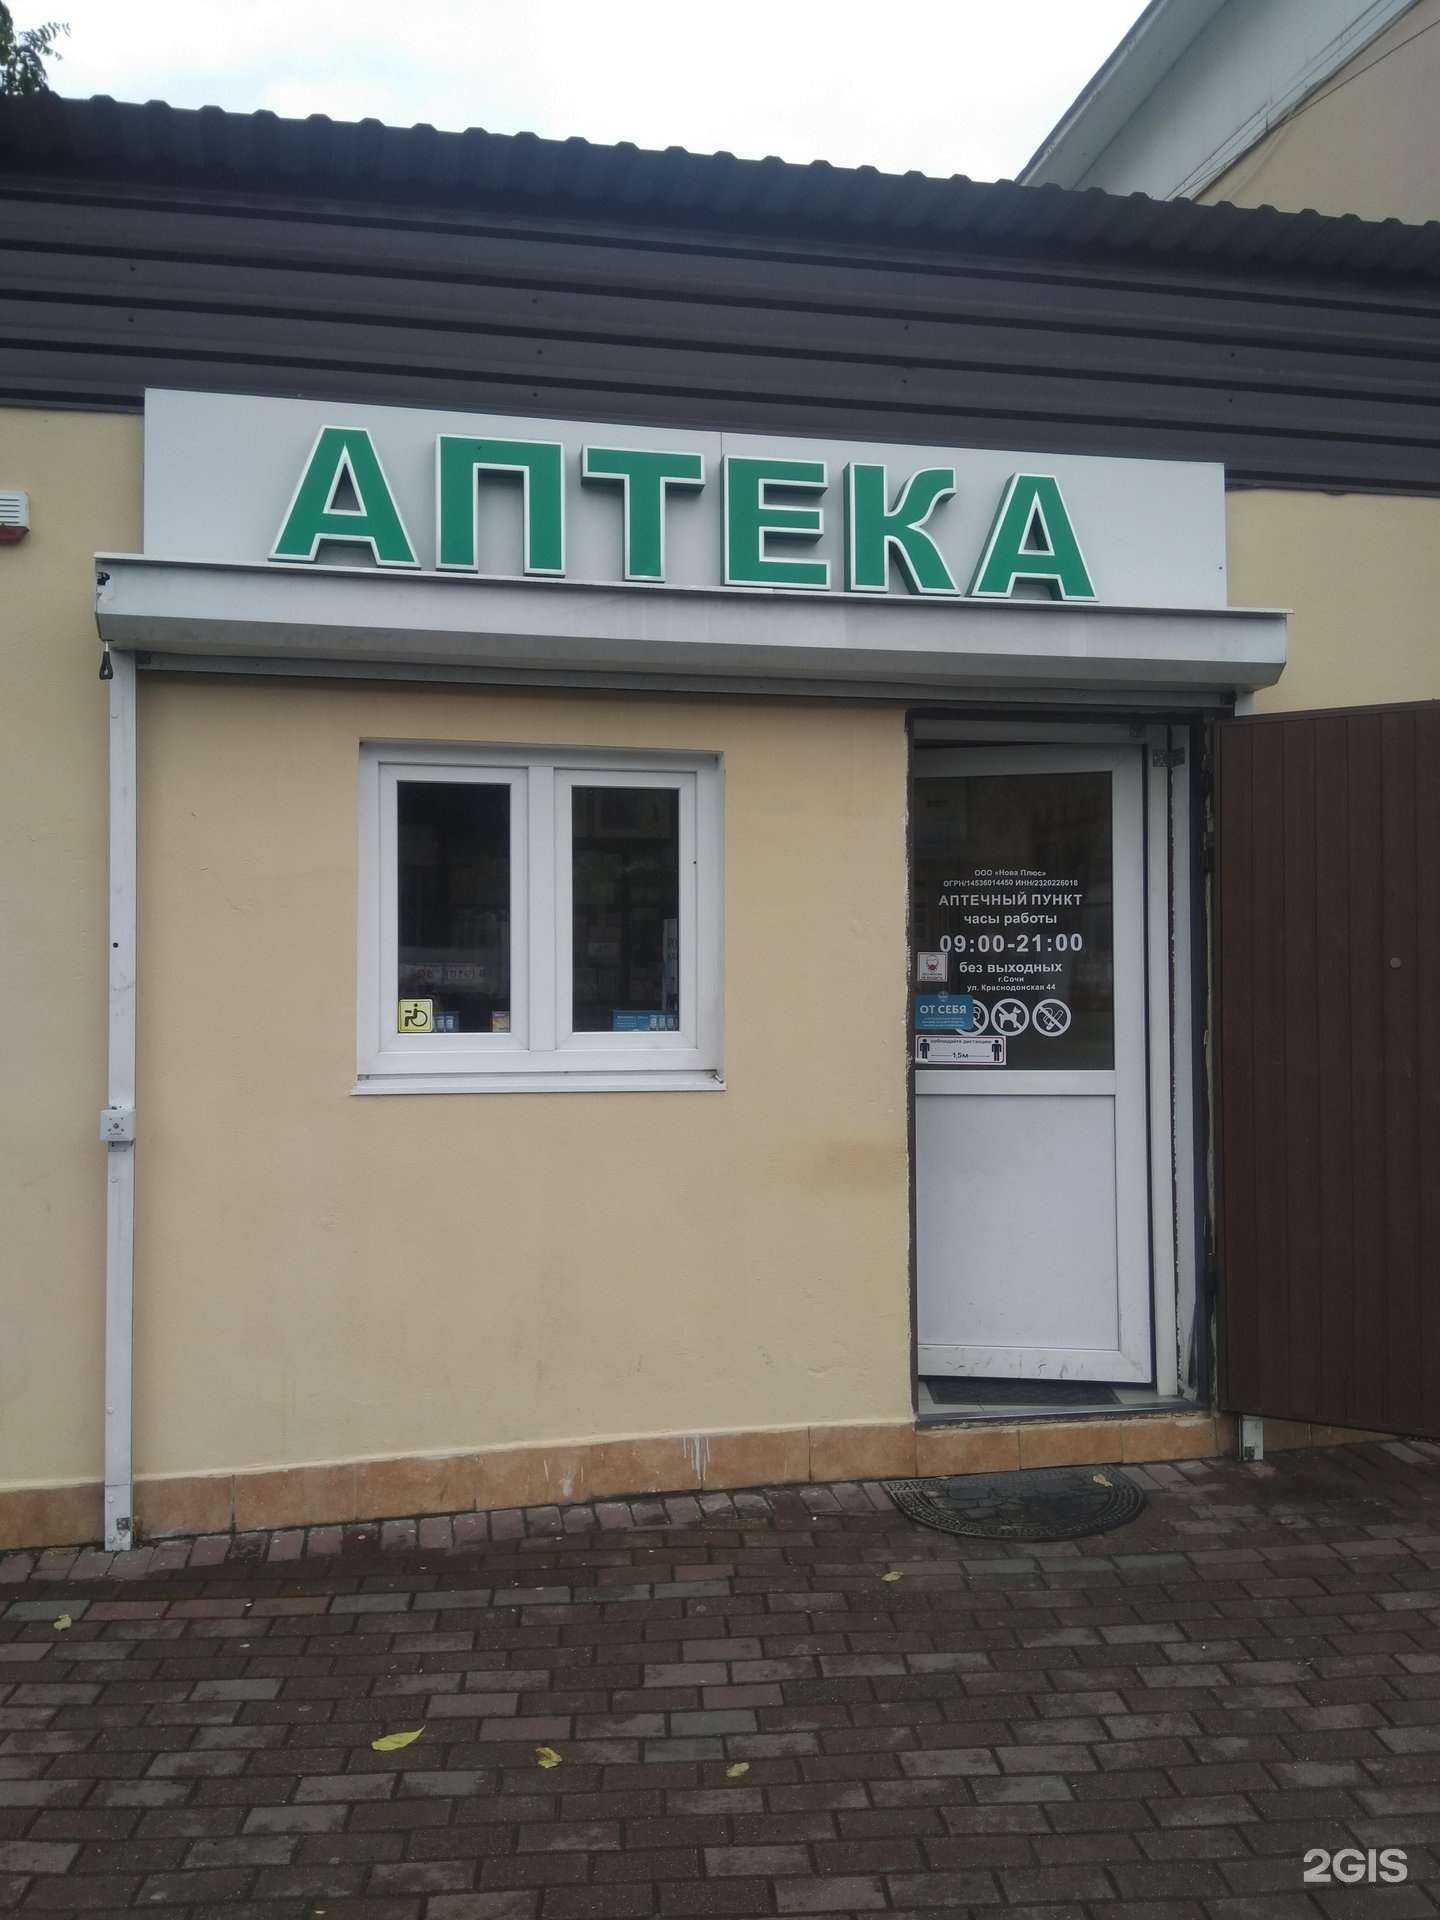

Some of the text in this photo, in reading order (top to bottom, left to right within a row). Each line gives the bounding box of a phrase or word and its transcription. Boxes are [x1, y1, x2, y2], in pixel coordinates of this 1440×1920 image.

[268, 426, 1099, 602] АПТЕКА
[974, 869, 993, 877] ООО
[938, 891, 1083, 906] АПТЕЧНЫЙ ПУНКТ
[964, 912, 1057, 926] часы работы
[939, 933, 1083, 953] 09:00-21:00
[959, 962, 1063, 974] без выходных
[981, 984, 1044, 992] Краснодонская
[920, 1005, 967, 1014] ОТ СЕБЯ
